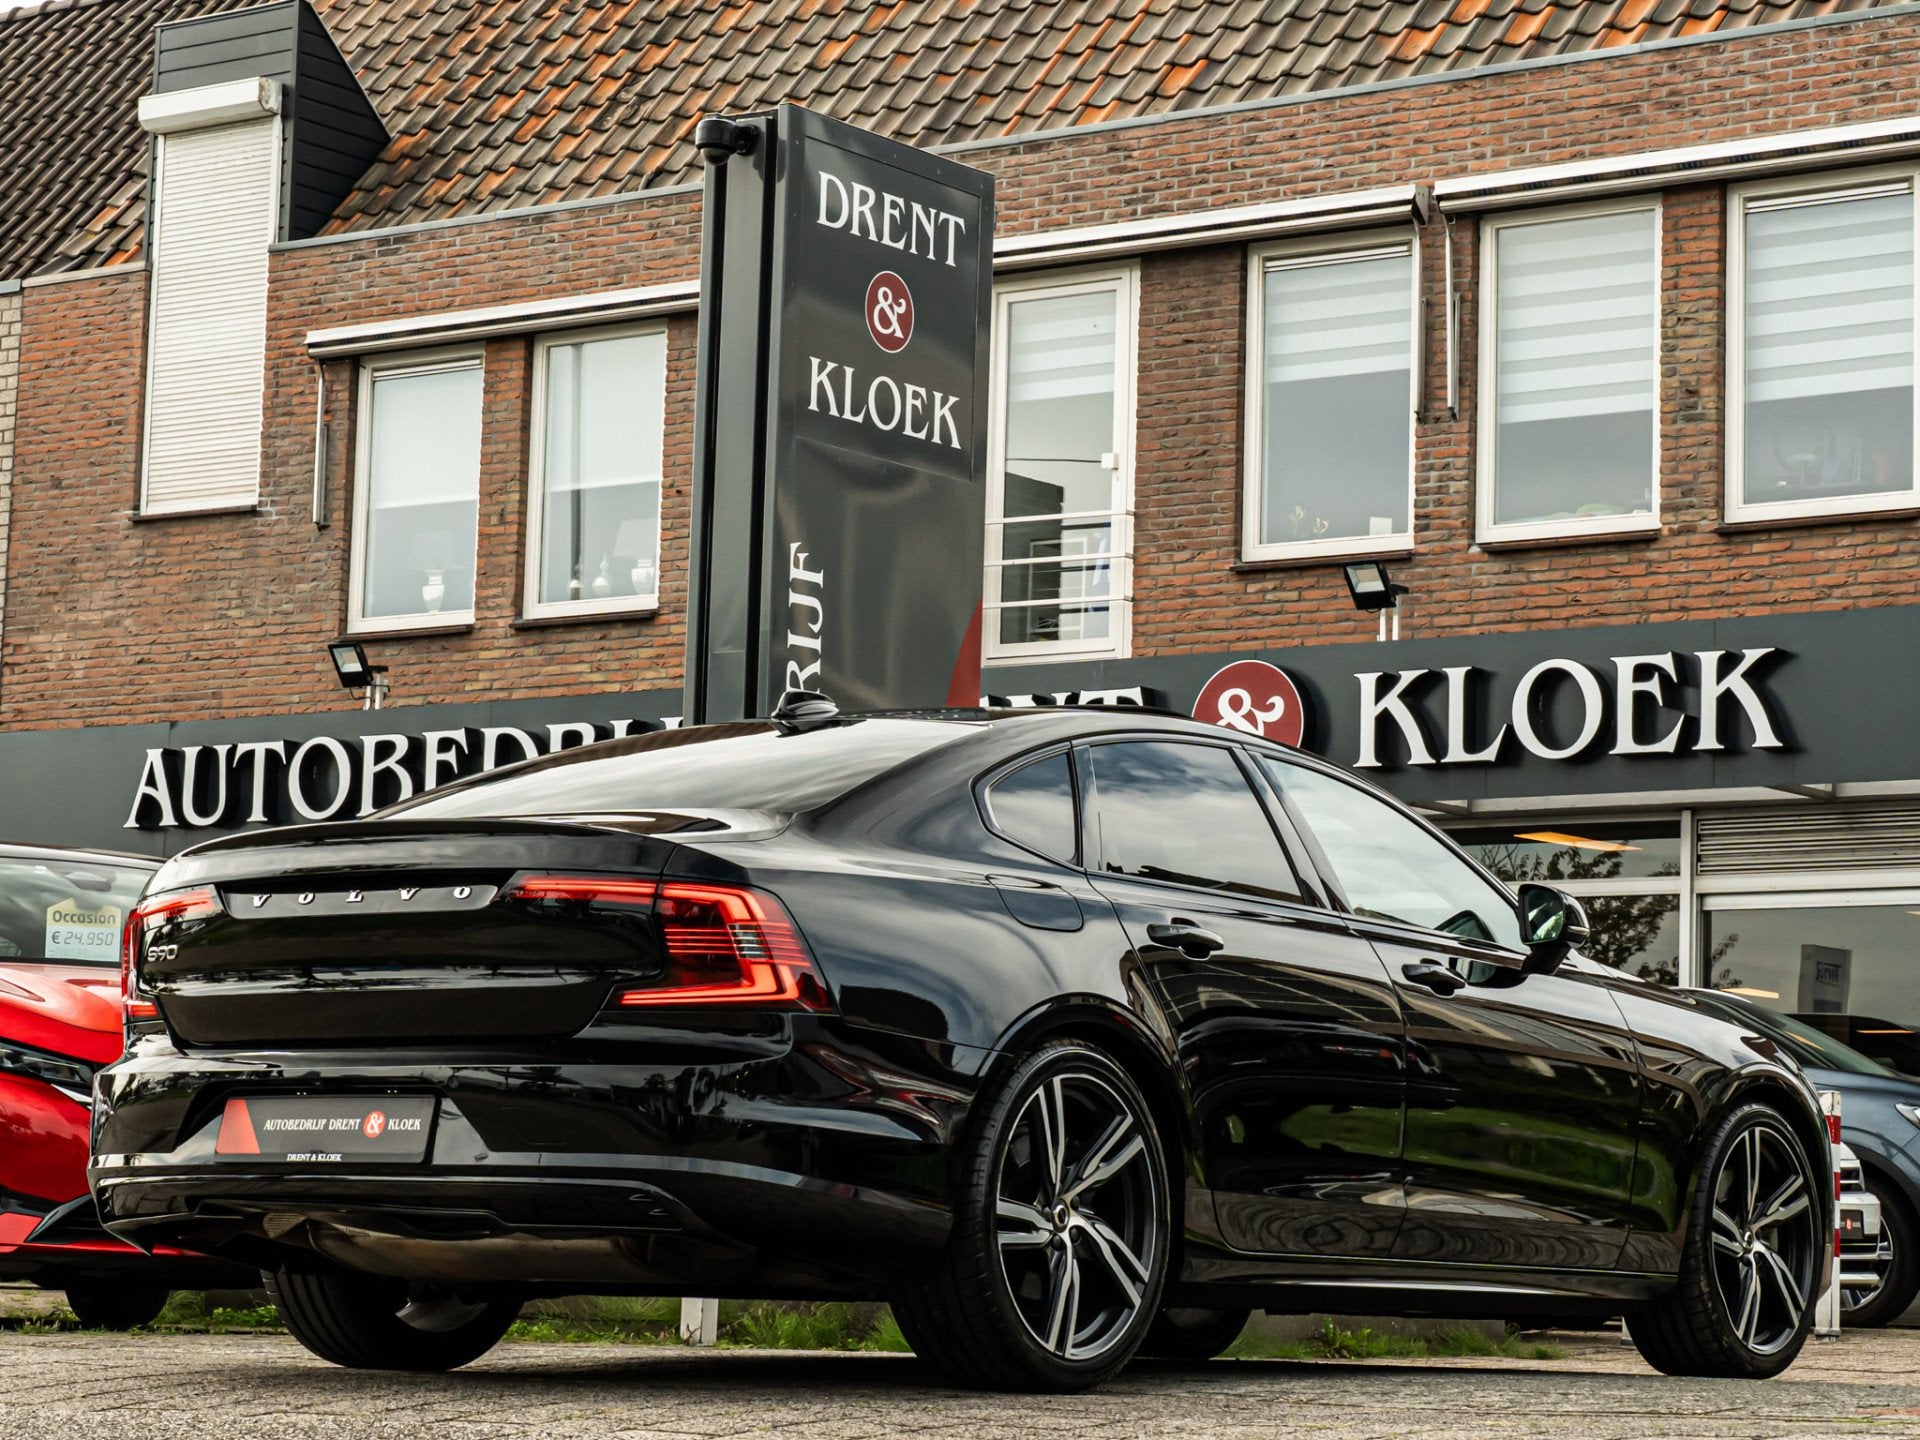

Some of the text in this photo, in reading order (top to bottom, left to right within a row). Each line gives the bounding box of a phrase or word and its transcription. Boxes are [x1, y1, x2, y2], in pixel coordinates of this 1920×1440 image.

[817, 171, 966, 267] DRENT
[873, 286, 907, 339] &
[807, 355, 961, 450] KLOEK
[1215, 687, 1285, 737] &
[1353, 647, 1783, 769] KLOEK
[252, 886, 473, 908] VOLVO
[52, 910, 116, 924] Occasion
[63, 931, 114, 946] 24.950
[147, 944, 178, 962] S90
[263, 1113, 421, 1133] AUTOBEDRIJF DRENT & KLOEK
[286, 1153, 310, 1162] DRENT
[317, 1153, 342, 1162] KLOEK
